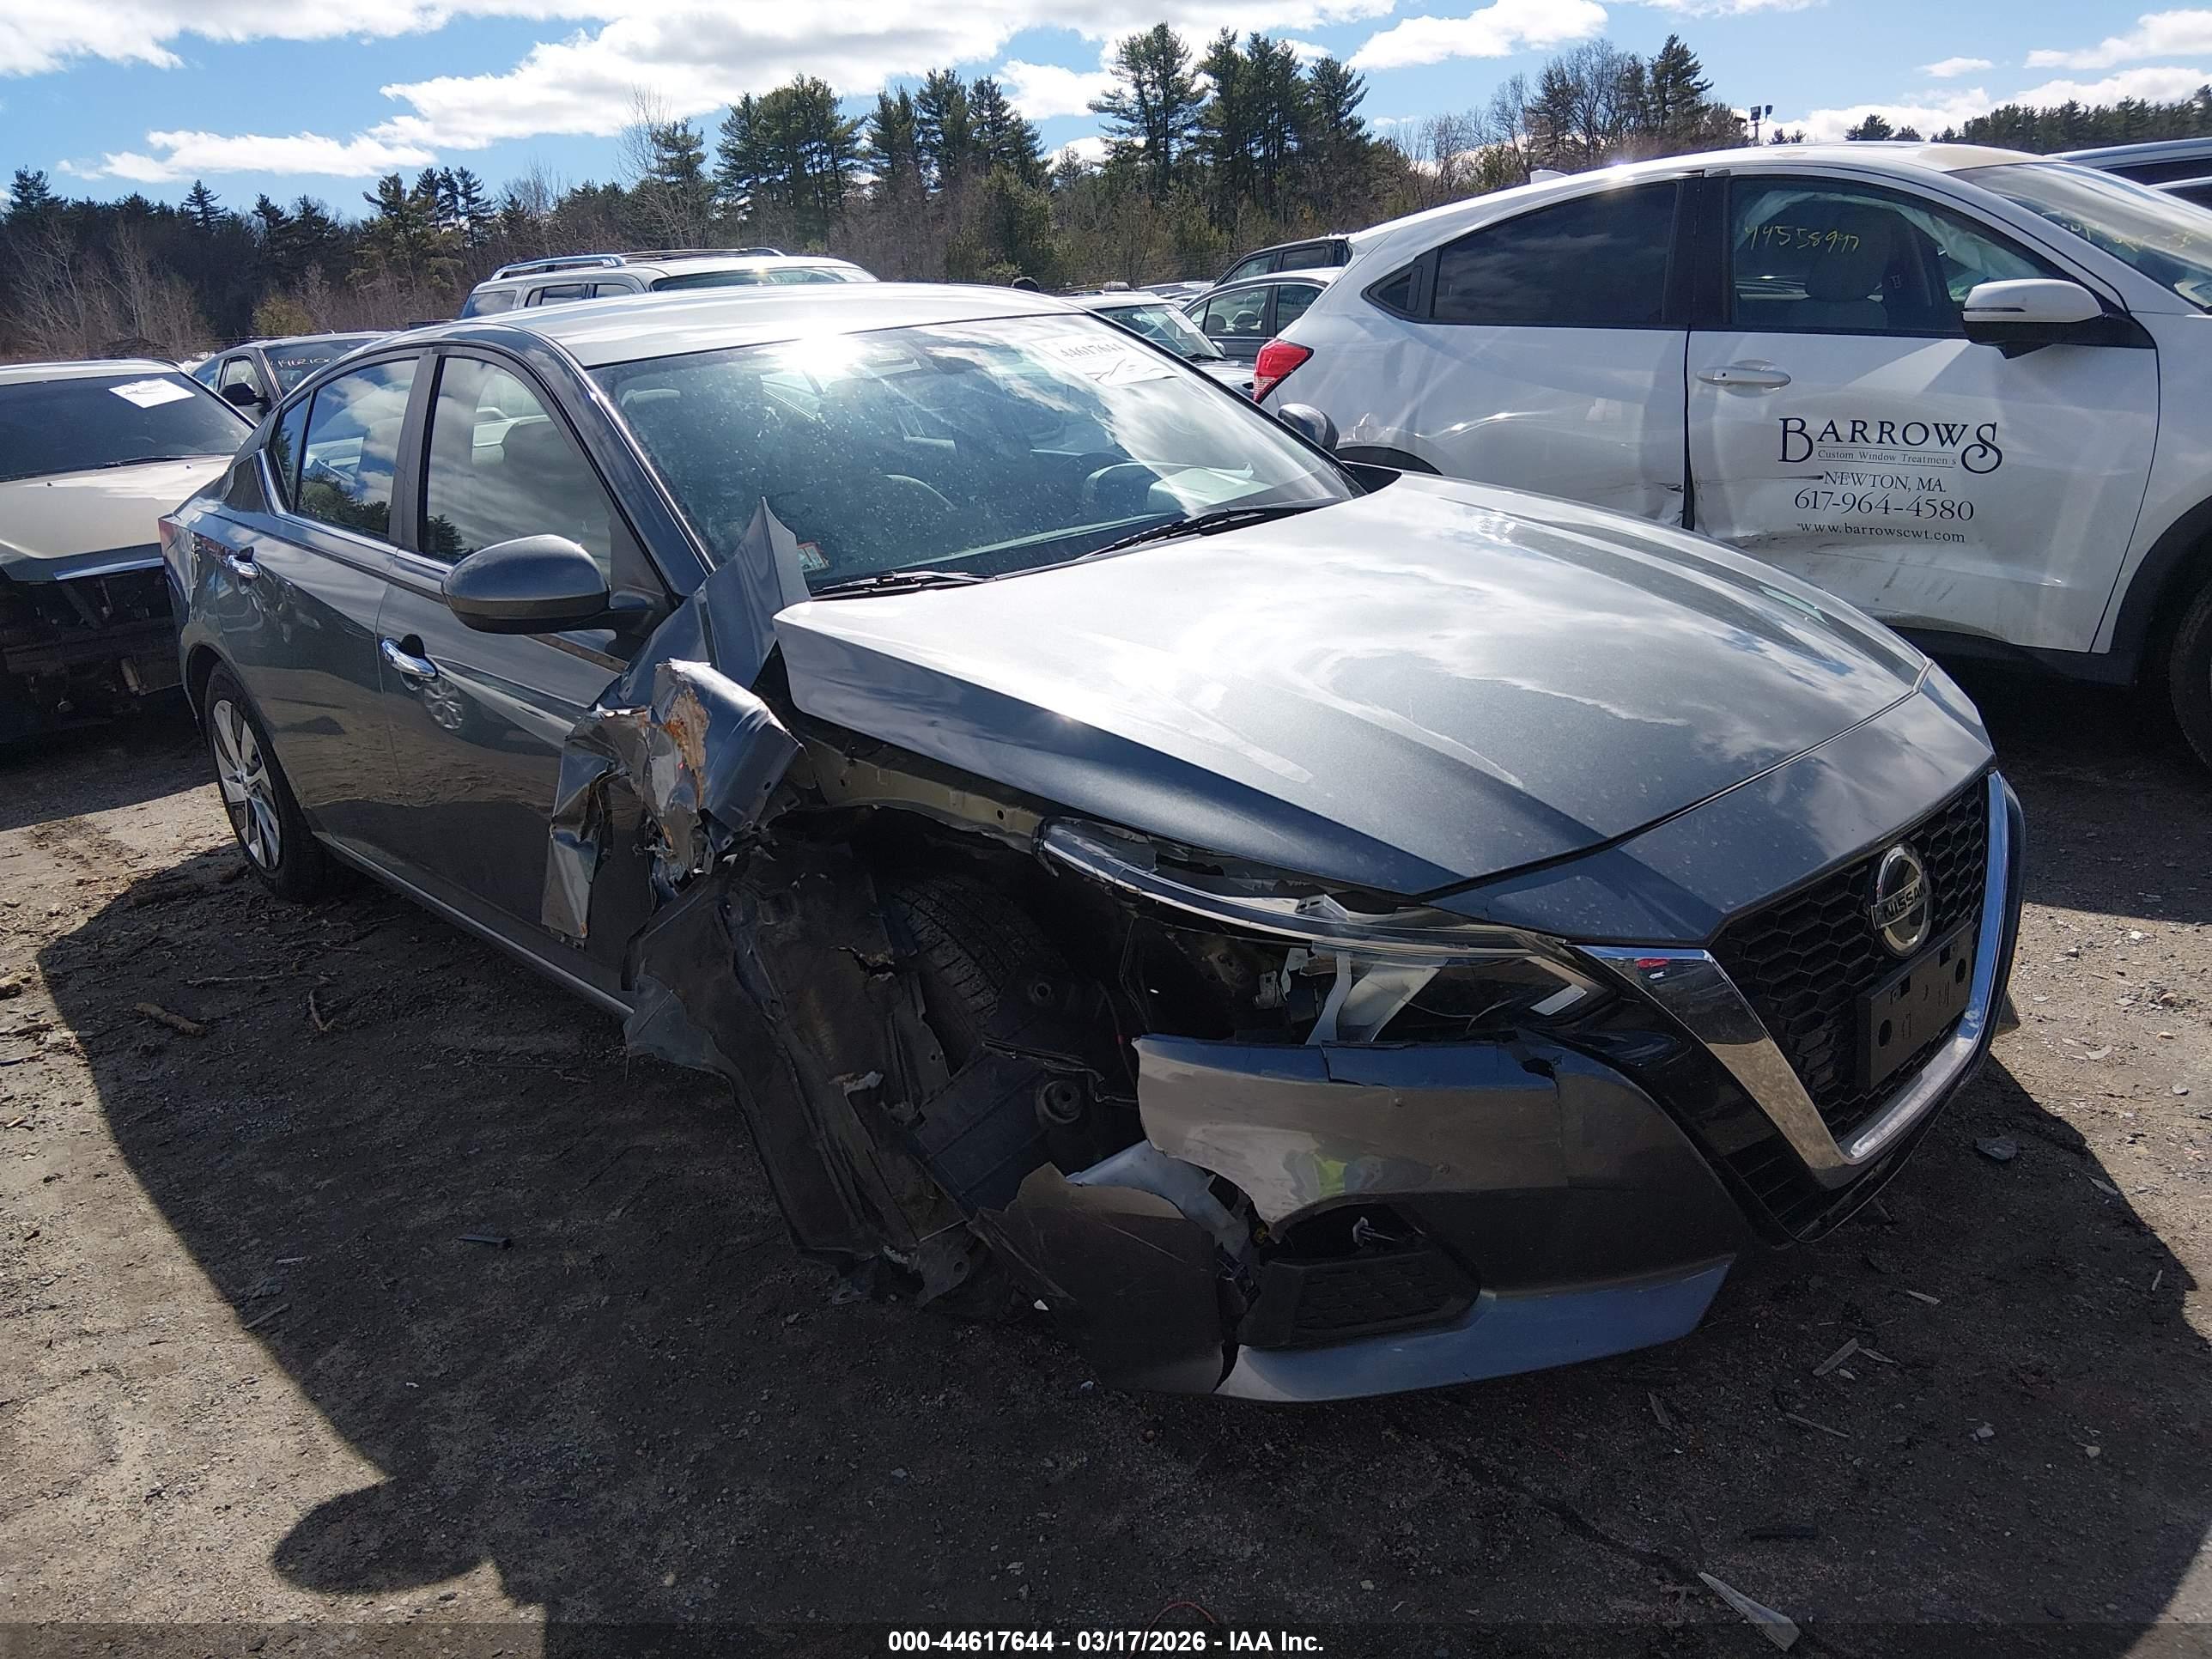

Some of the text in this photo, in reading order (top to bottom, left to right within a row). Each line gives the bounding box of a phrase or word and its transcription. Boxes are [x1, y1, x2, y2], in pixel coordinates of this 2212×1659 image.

[1778, 417, 2002, 474] BARROWS
[1818, 449, 1854, 459] Custom
[1859, 451, 1897, 461] Window
[1823, 471, 1911, 493] NEWTON,
[1794, 487, 1974, 521] 617-964-4580
[1800, 522, 1966, 543] www.barrowscwt.com
[1884, 881, 1925, 917] NISSAN
